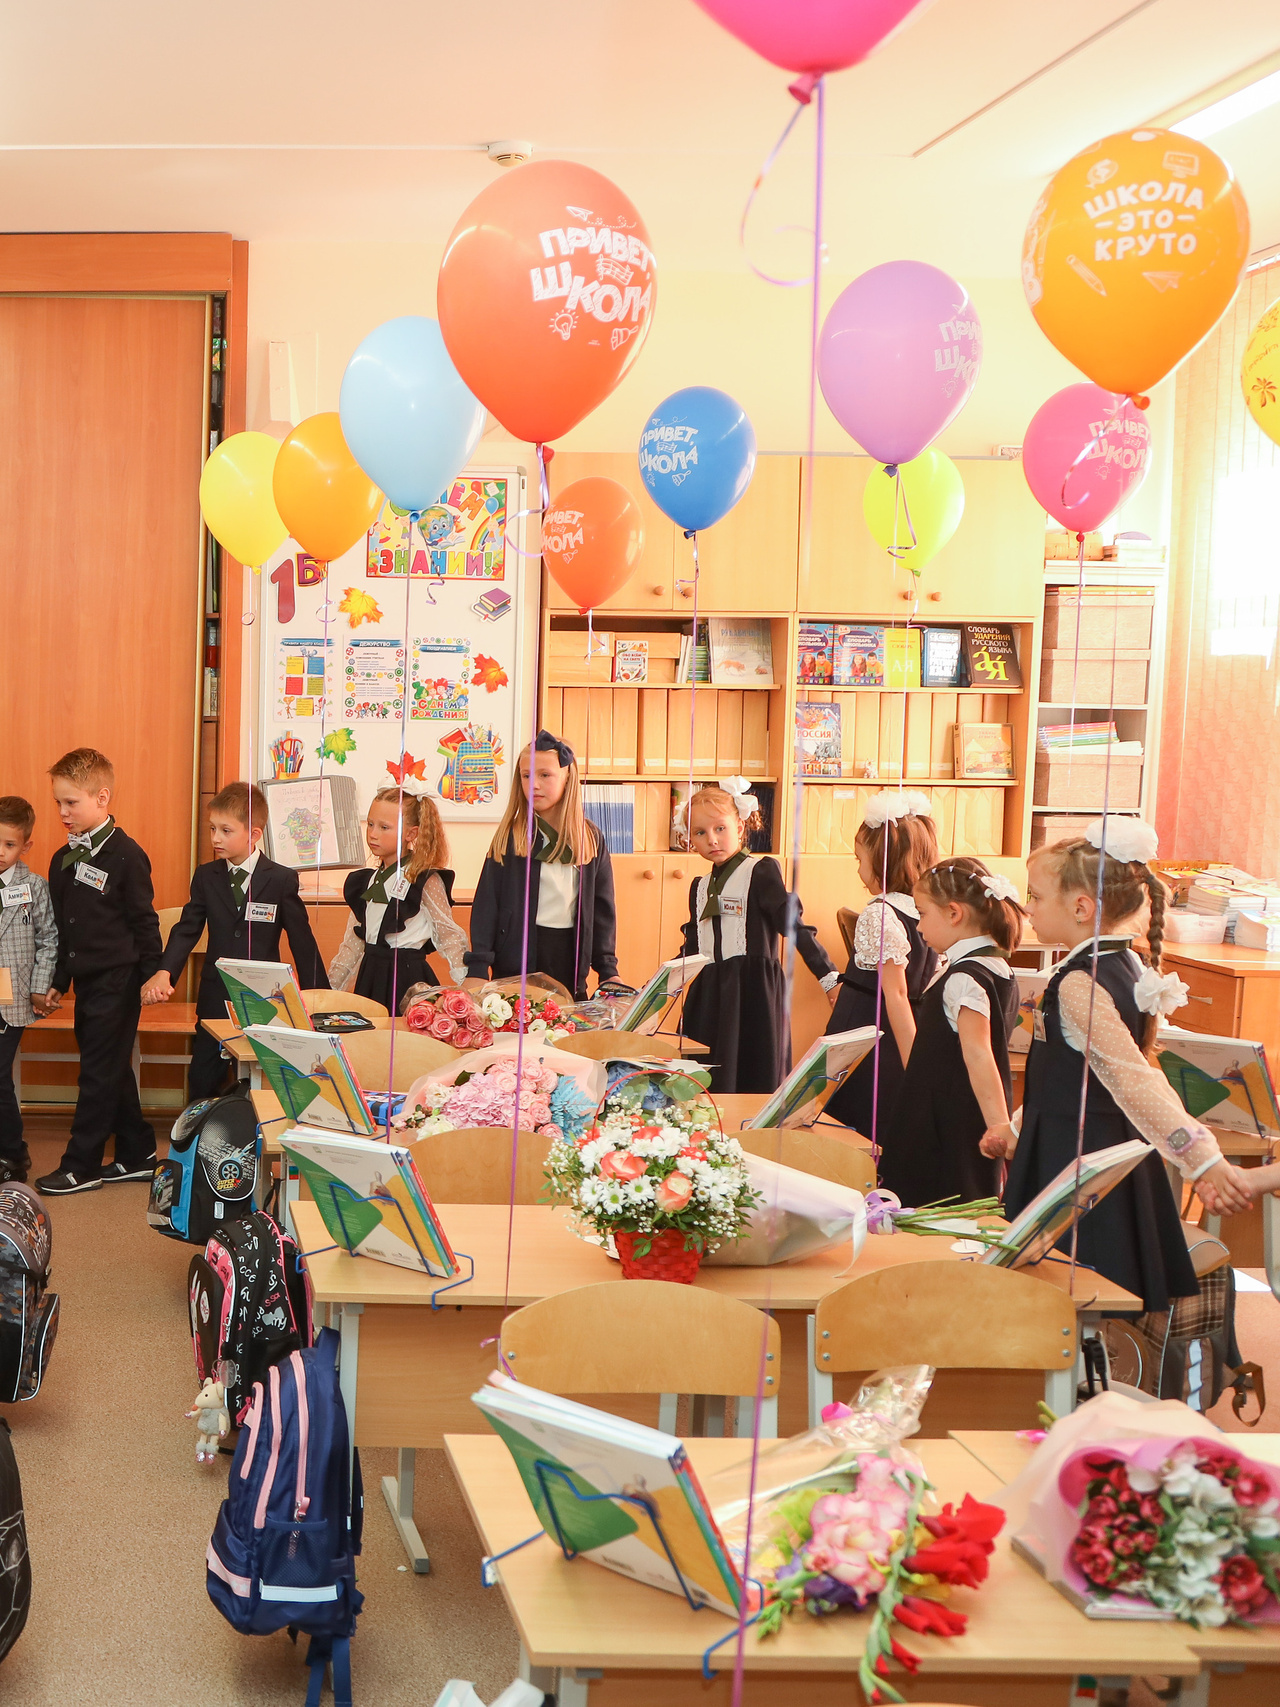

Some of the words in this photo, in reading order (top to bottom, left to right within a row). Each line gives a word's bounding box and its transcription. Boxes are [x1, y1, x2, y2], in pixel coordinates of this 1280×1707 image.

[1082, 180, 1205, 220] ШКОЛА
[1094, 232, 1198, 262] КРУТО
[530, 260, 652, 323] ШКОЛА
[641, 425, 699, 447] ПРИВЕТ,
[639, 446, 699, 475] ШКОЛА
[1084, 438, 1147, 471] ШКОЛ
[379, 548, 494, 578] ЗНАНИЙ!
[967, 625, 1000, 634] СЛОВАРЬ
[973, 633, 1011, 641] УДАРЕНИЙ
[971, 639, 1009, 648] РУССКОГО
[987, 646, 1013, 654] ЯЗЫКА
[418, 699, 428, 710] С
[412, 709, 468, 719] РОЖДЕНИЯ!
[797, 730, 832, 739] РОССИЯ
